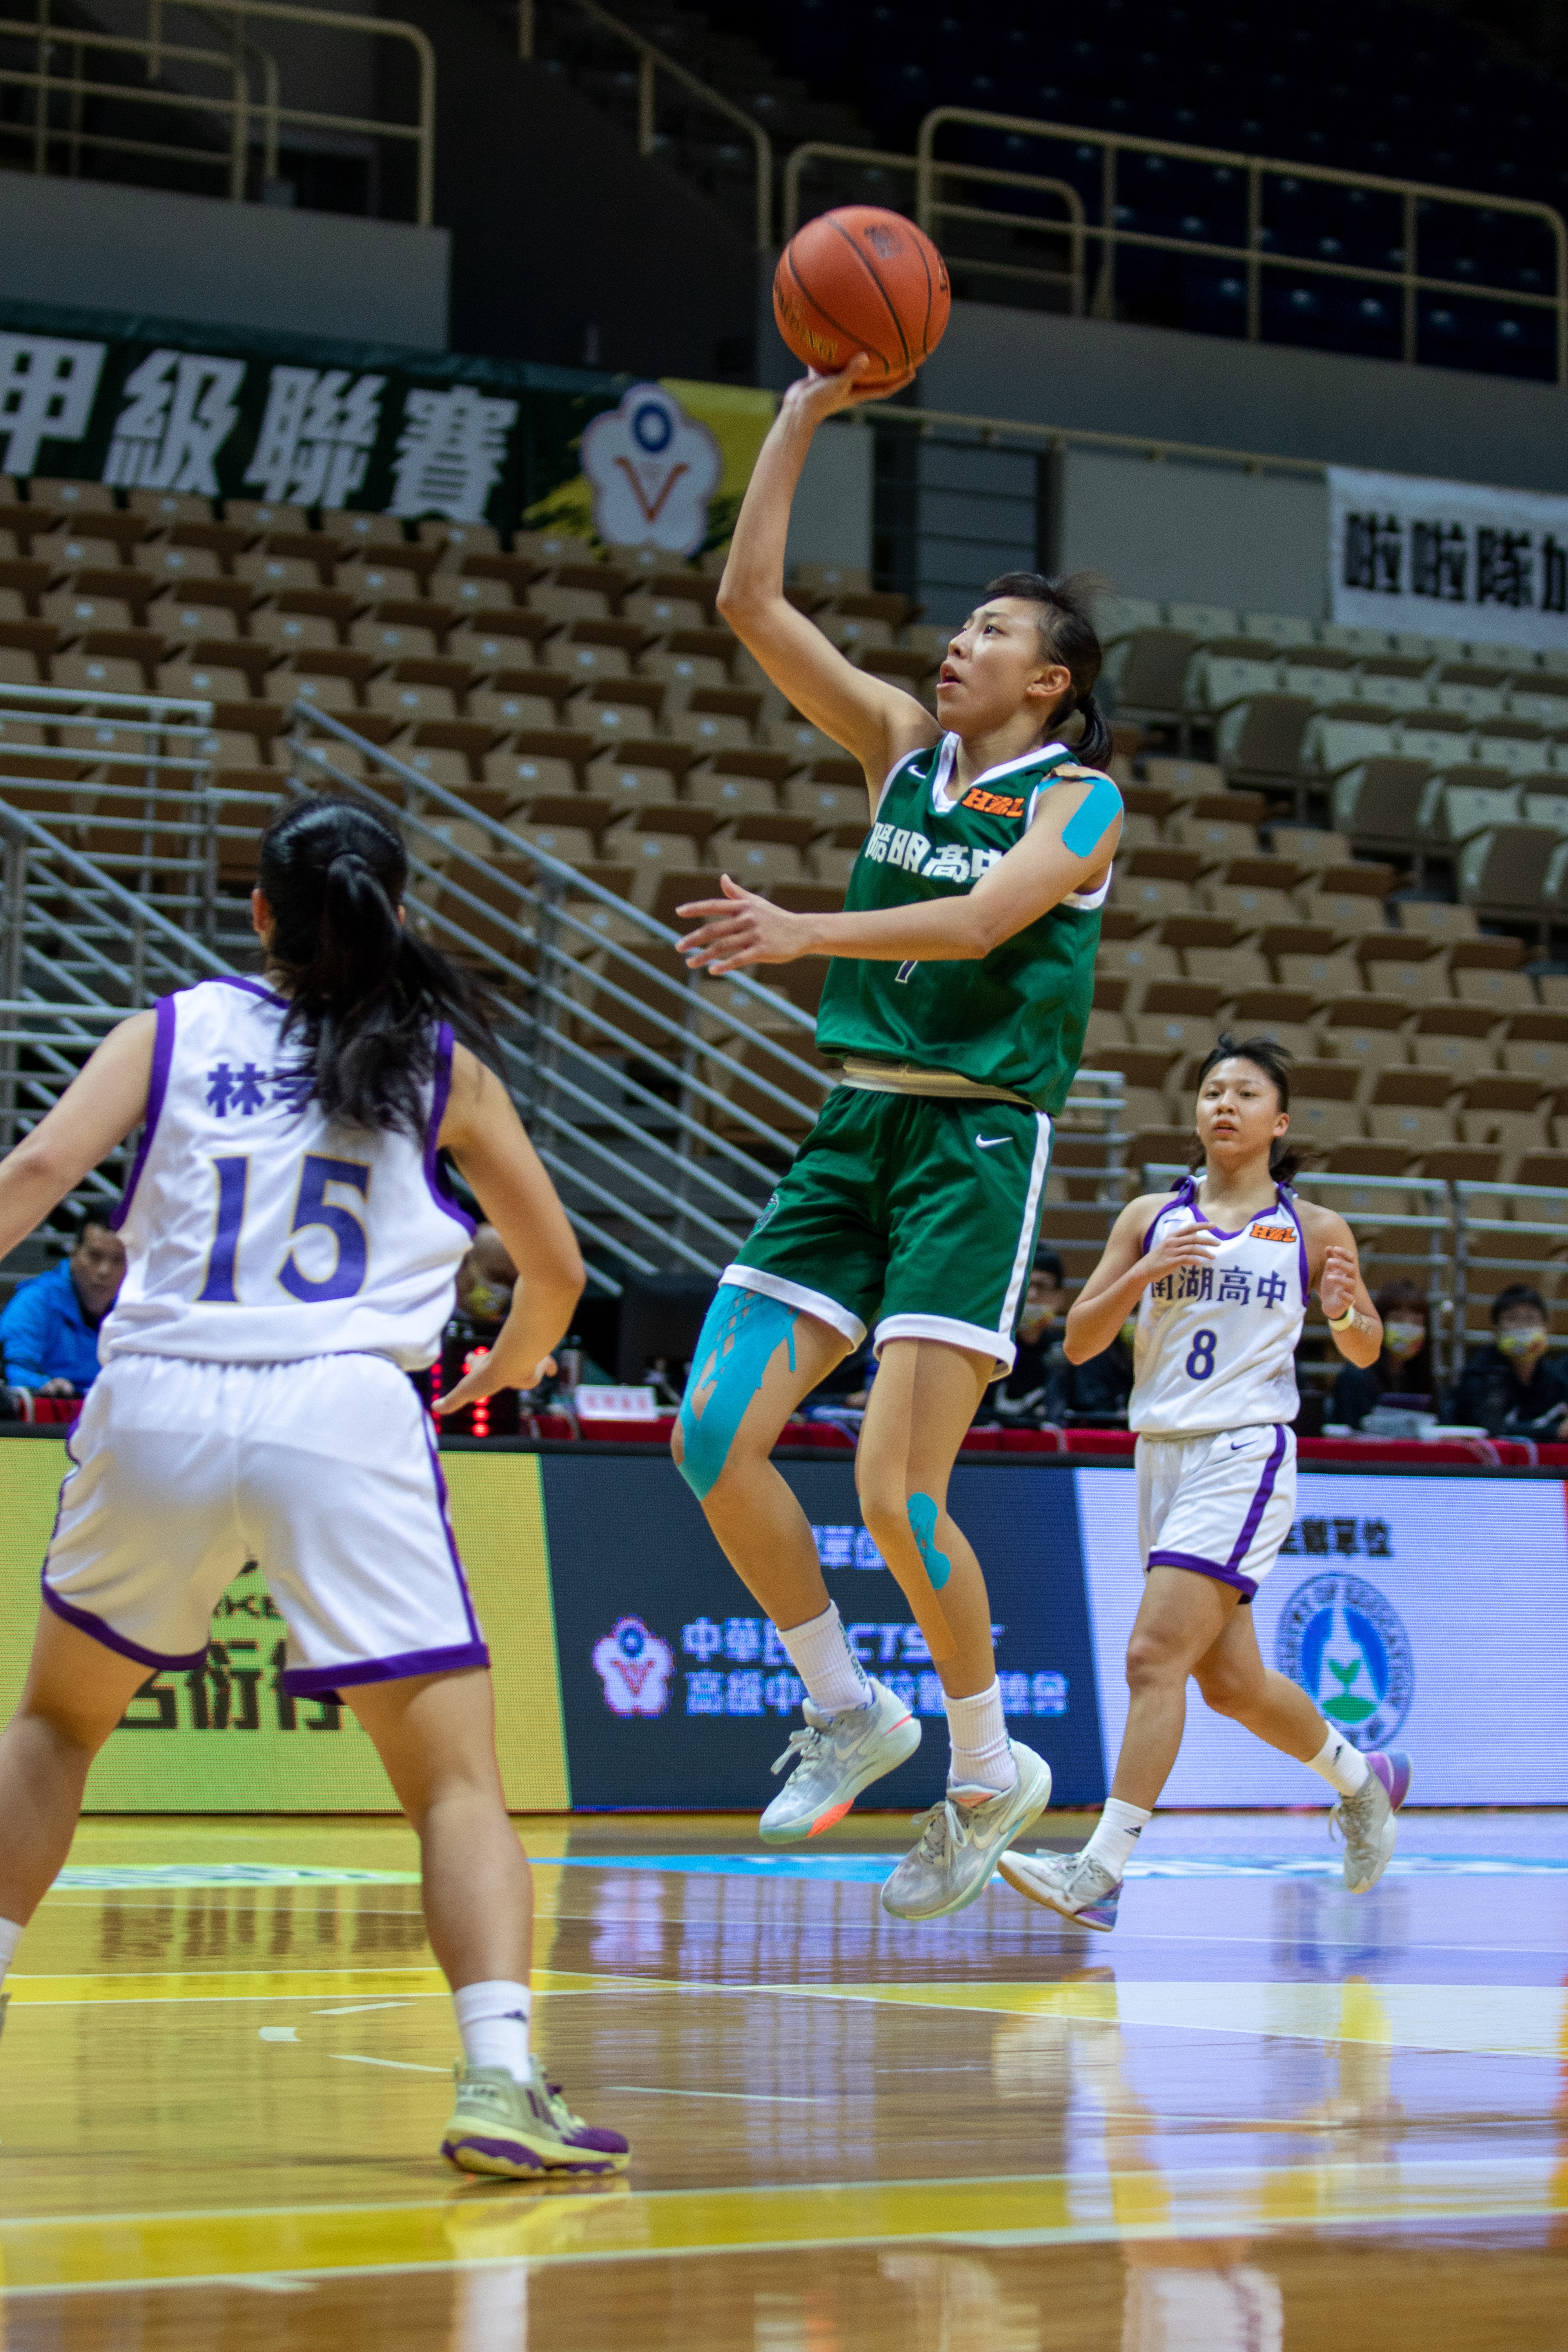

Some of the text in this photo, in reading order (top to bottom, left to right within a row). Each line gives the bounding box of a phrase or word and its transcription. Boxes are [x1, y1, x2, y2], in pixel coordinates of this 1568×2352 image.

[0, 331, 520, 526] 甲級聯賽
[960, 786, 1026, 818] HBL
[192, 1152, 372, 1306] 15
[1250, 1223, 1297, 1243] HBL
[1185, 1329, 1218, 1380] 8
